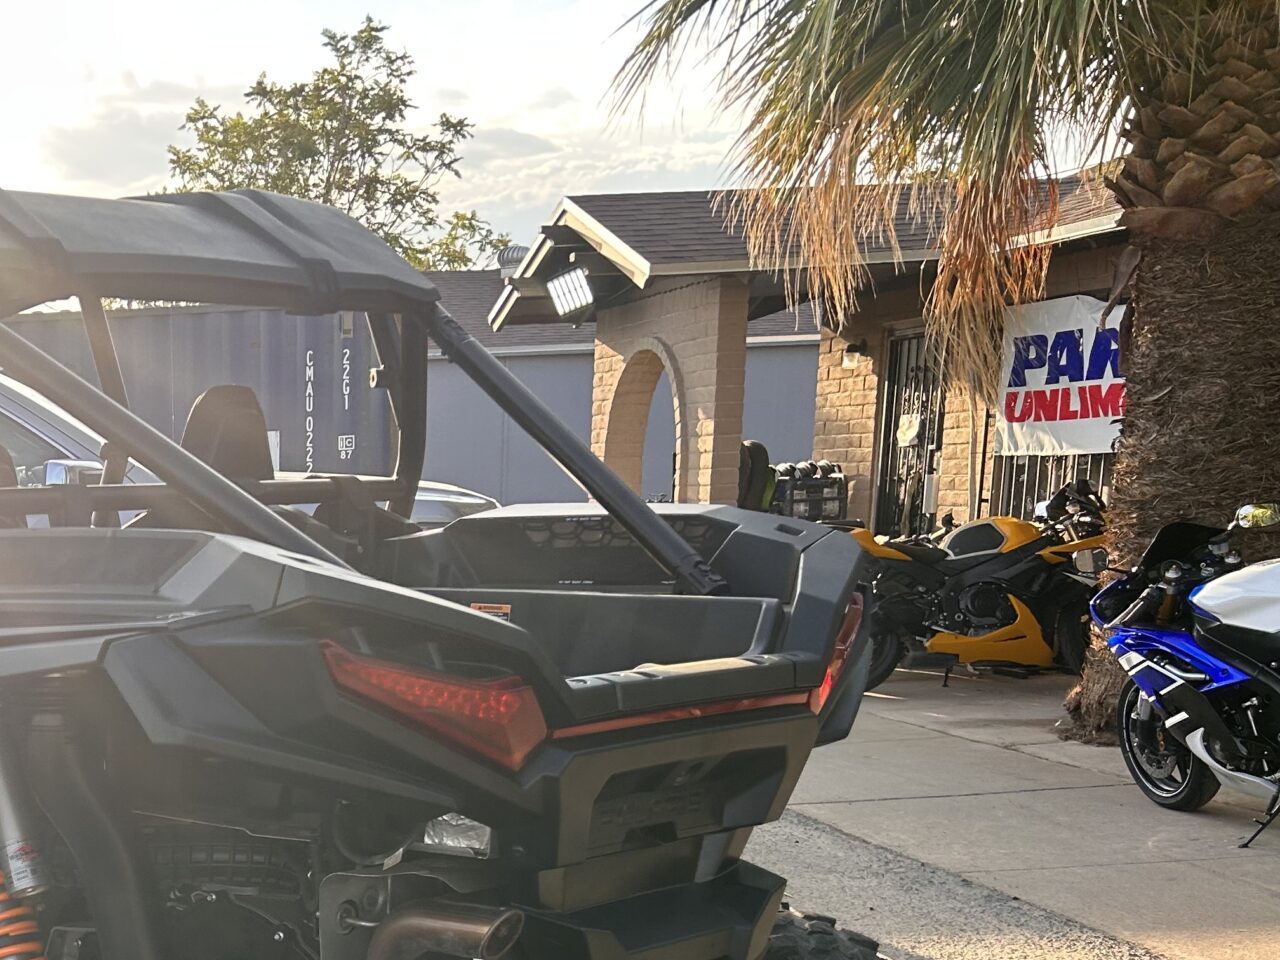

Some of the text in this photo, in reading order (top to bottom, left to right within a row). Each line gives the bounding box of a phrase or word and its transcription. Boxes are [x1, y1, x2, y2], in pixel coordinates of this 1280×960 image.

[305, 350, 314, 412] CMAU
[342, 348, 350, 410] 22G1
[340, 450, 352, 459] 87
